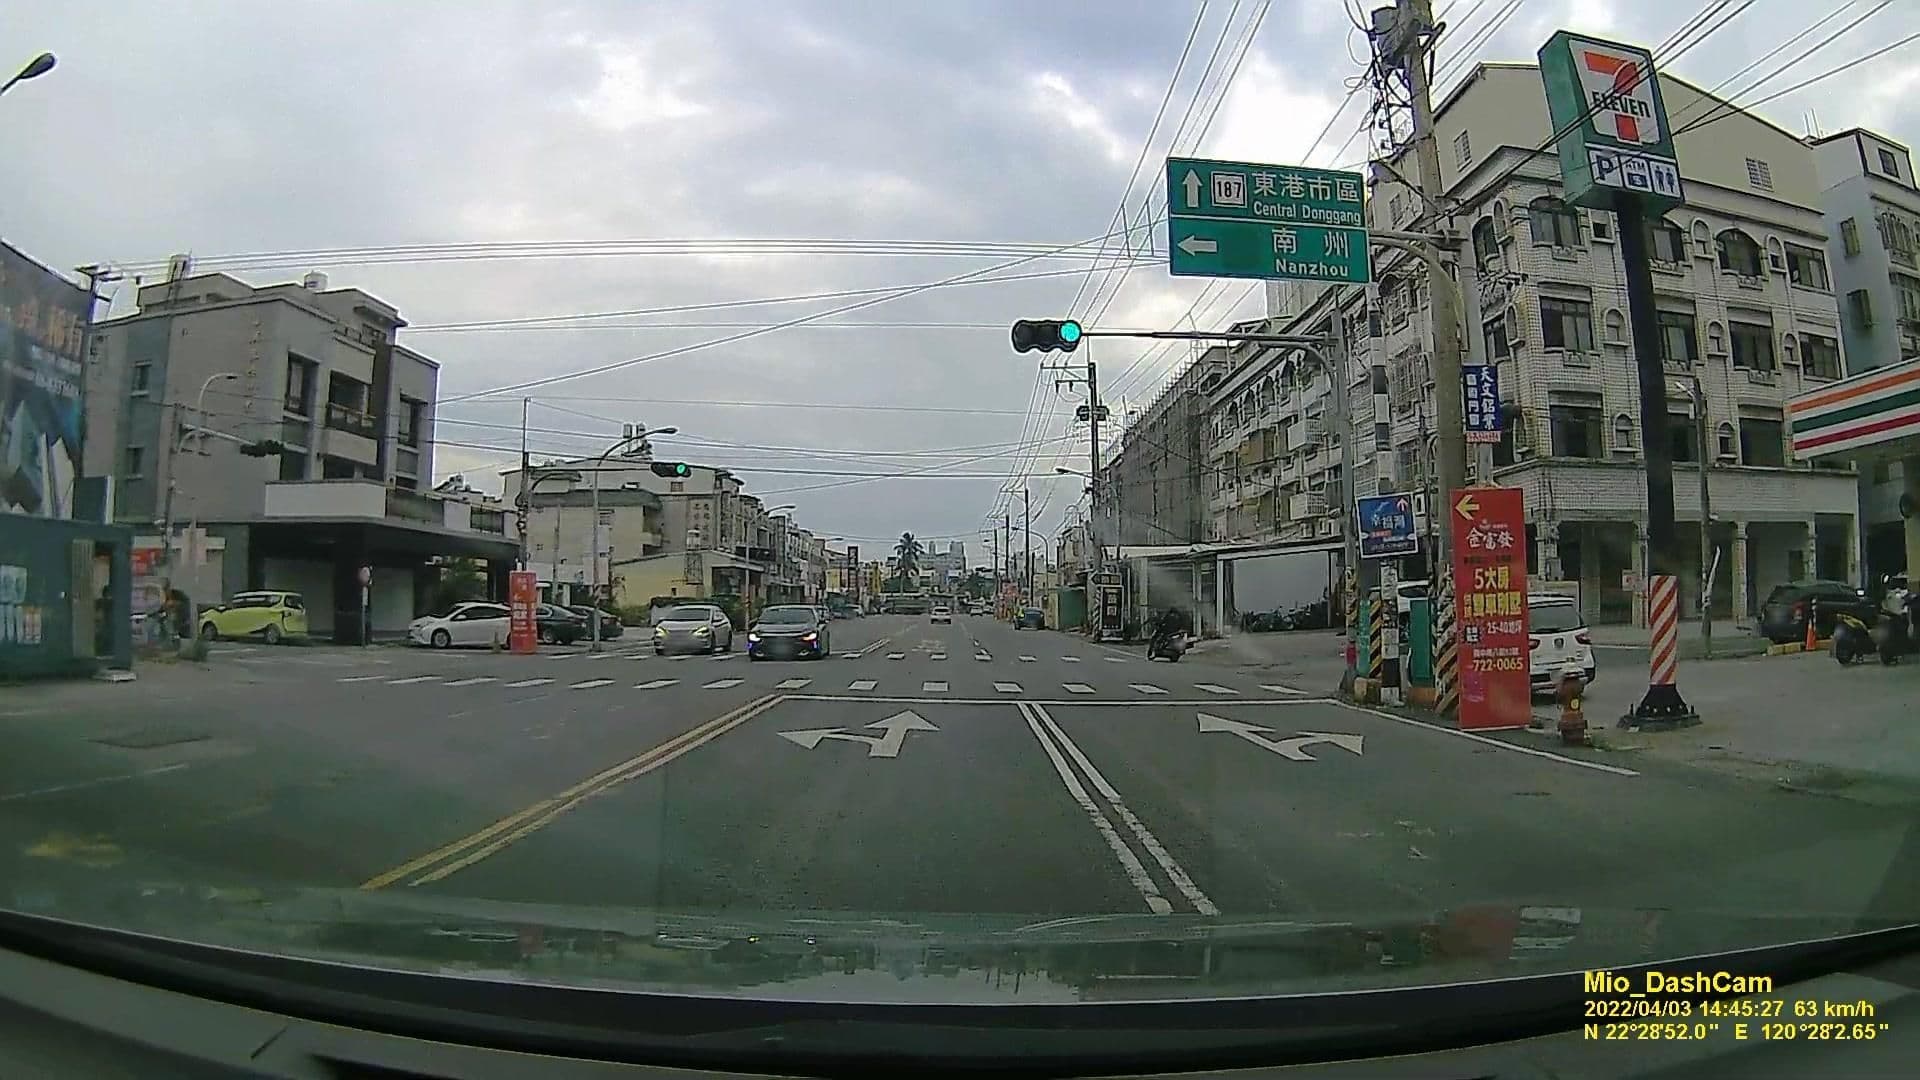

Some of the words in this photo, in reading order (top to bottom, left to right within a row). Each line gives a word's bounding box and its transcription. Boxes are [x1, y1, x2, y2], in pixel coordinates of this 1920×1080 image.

[1625, 159, 1645, 170] ATM
[1215, 179, 1241, 199] 187
[1251, 170, 1360, 203] 東港市區
[1253, 201, 1297, 219] Central
[1302, 205, 1362, 226] Donggang
[1271, 228, 1350, 259] 南州
[1275, 259, 1348, 277] Nanzhou
[1466, 527, 1514, 550] 金富發
